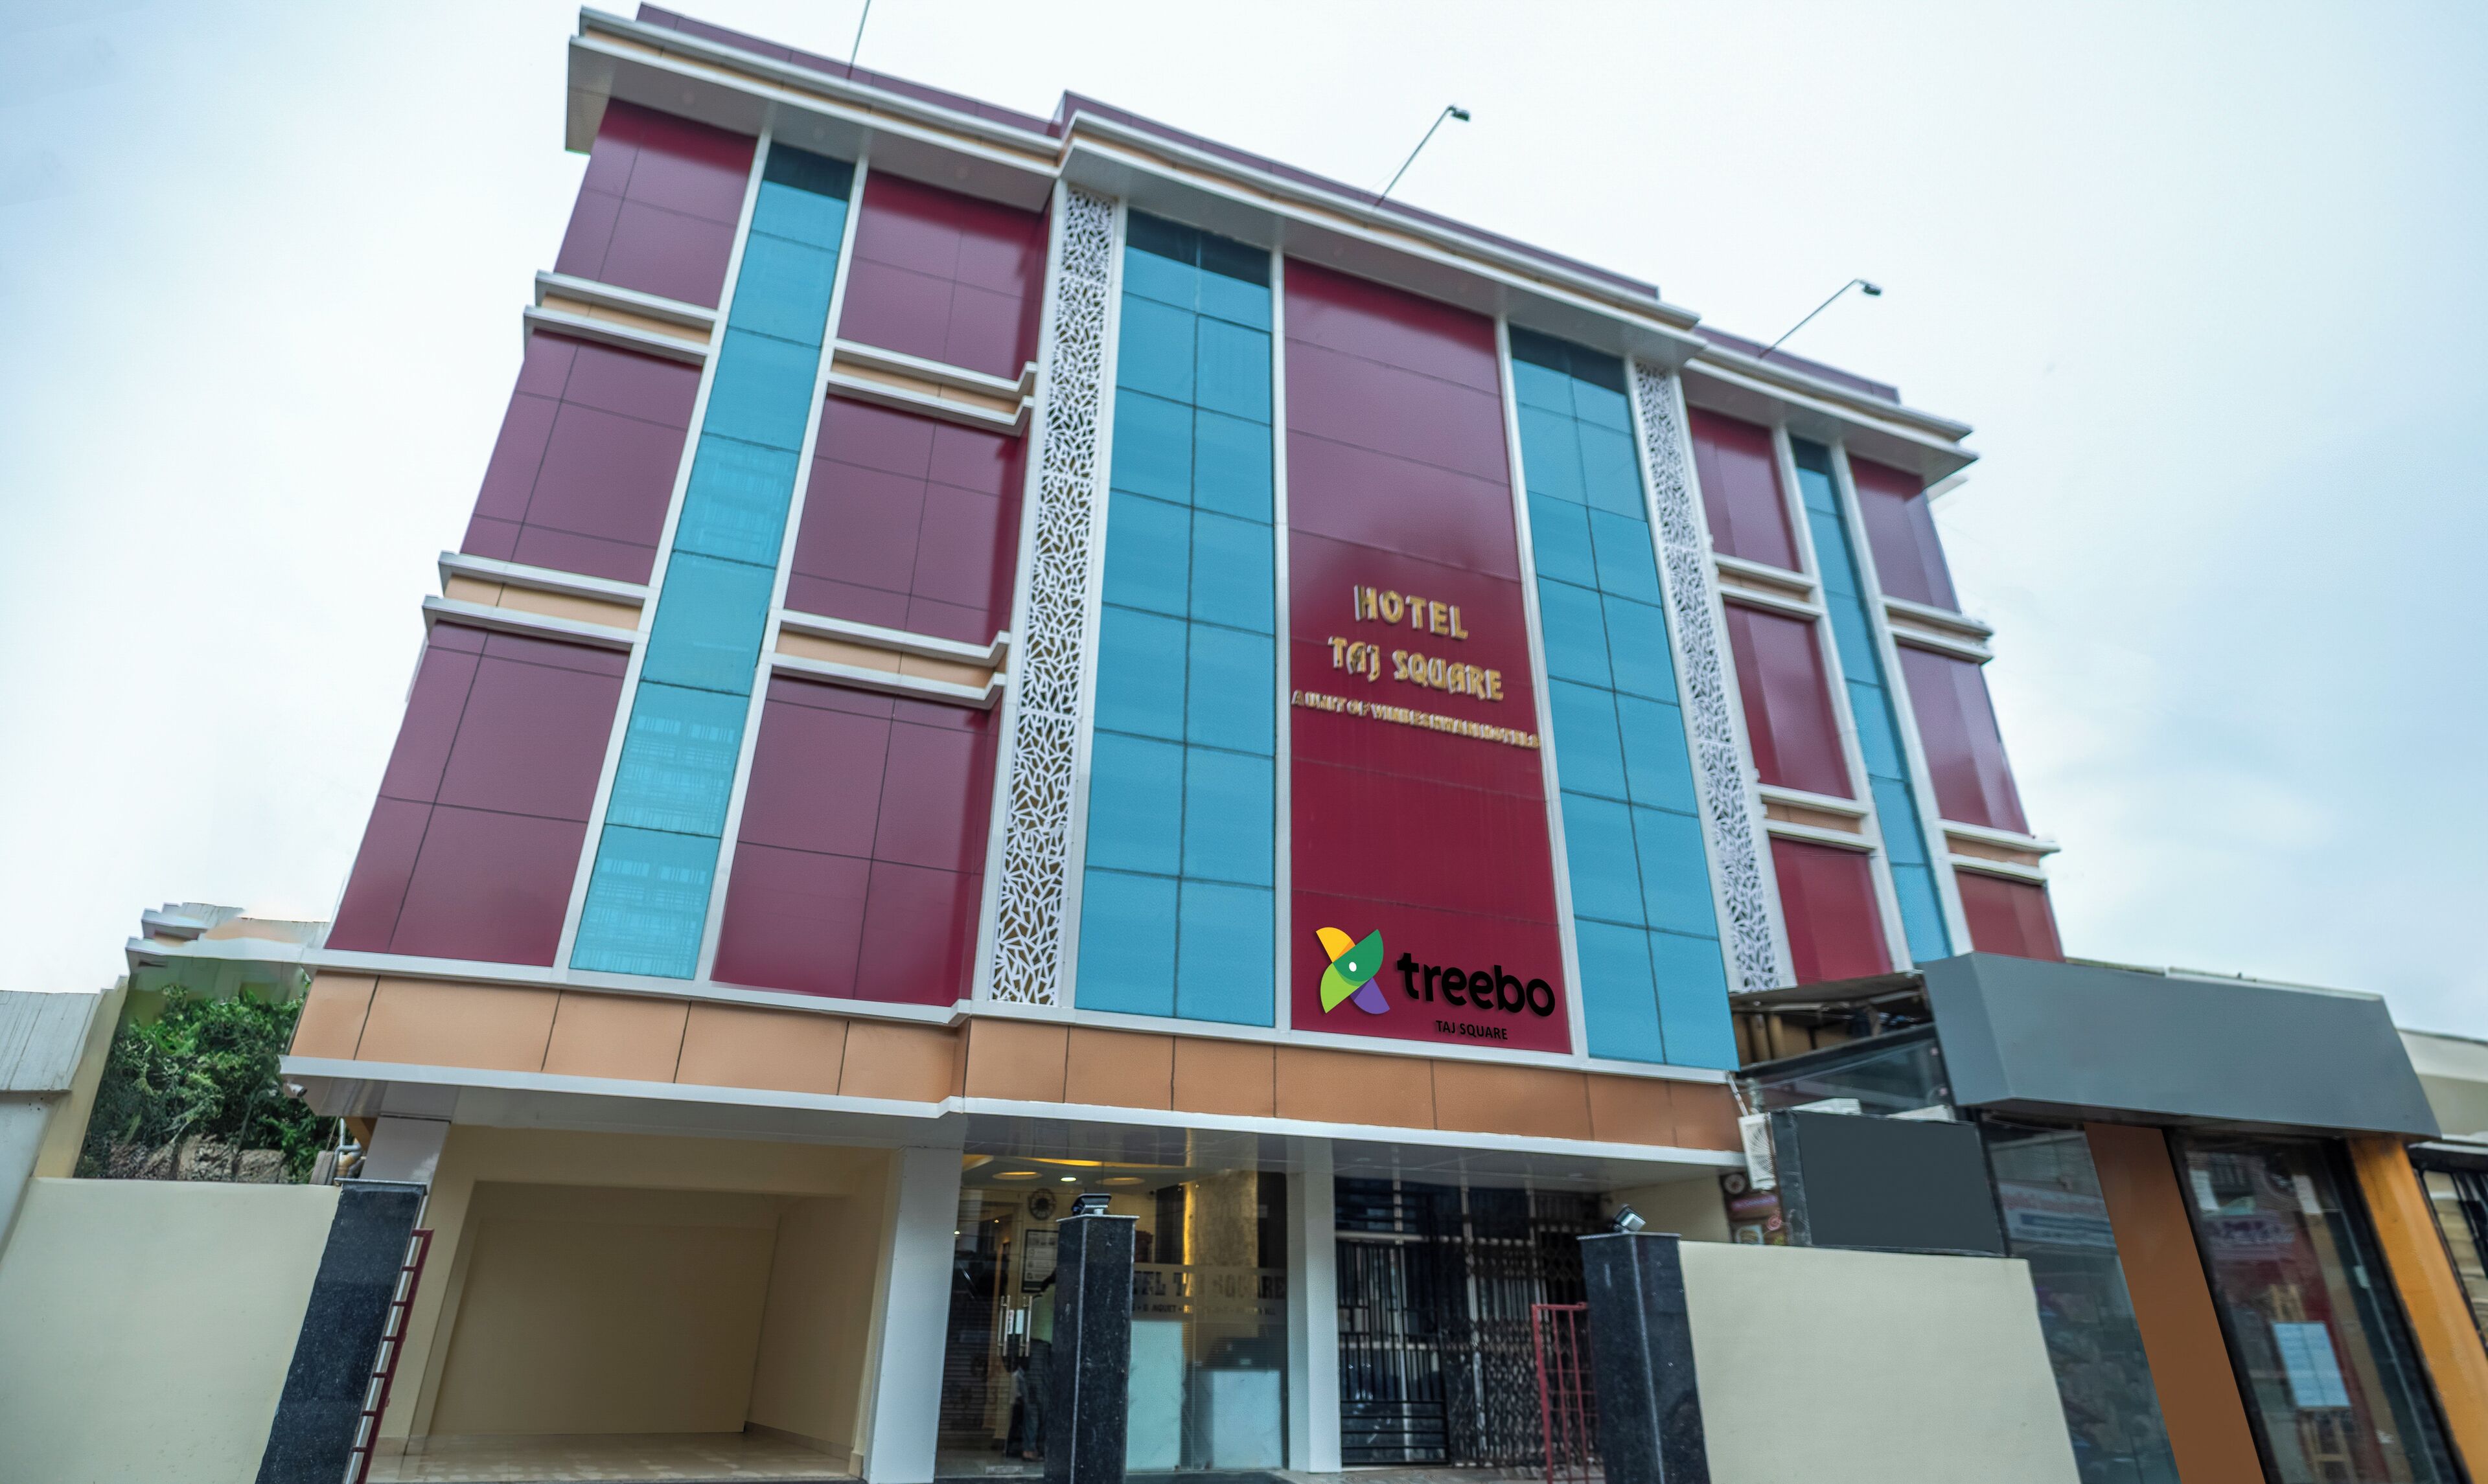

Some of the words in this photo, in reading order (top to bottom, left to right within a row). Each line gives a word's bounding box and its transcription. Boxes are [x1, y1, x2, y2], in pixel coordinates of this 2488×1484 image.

[1353, 584, 1468, 640] HOTEL
[1328, 635, 1381, 682] TAJ
[1392, 648, 1504, 701] SQUARE
[1291, 689, 1305, 706] A
[1305, 691, 1347, 713] UNIT
[1346, 700, 1370, 716] OF
[1397, 952, 1555, 1017] treebo
[1436, 1020, 1456, 1034] TAJ
[1460, 1023, 1508, 1040] SQUARE
